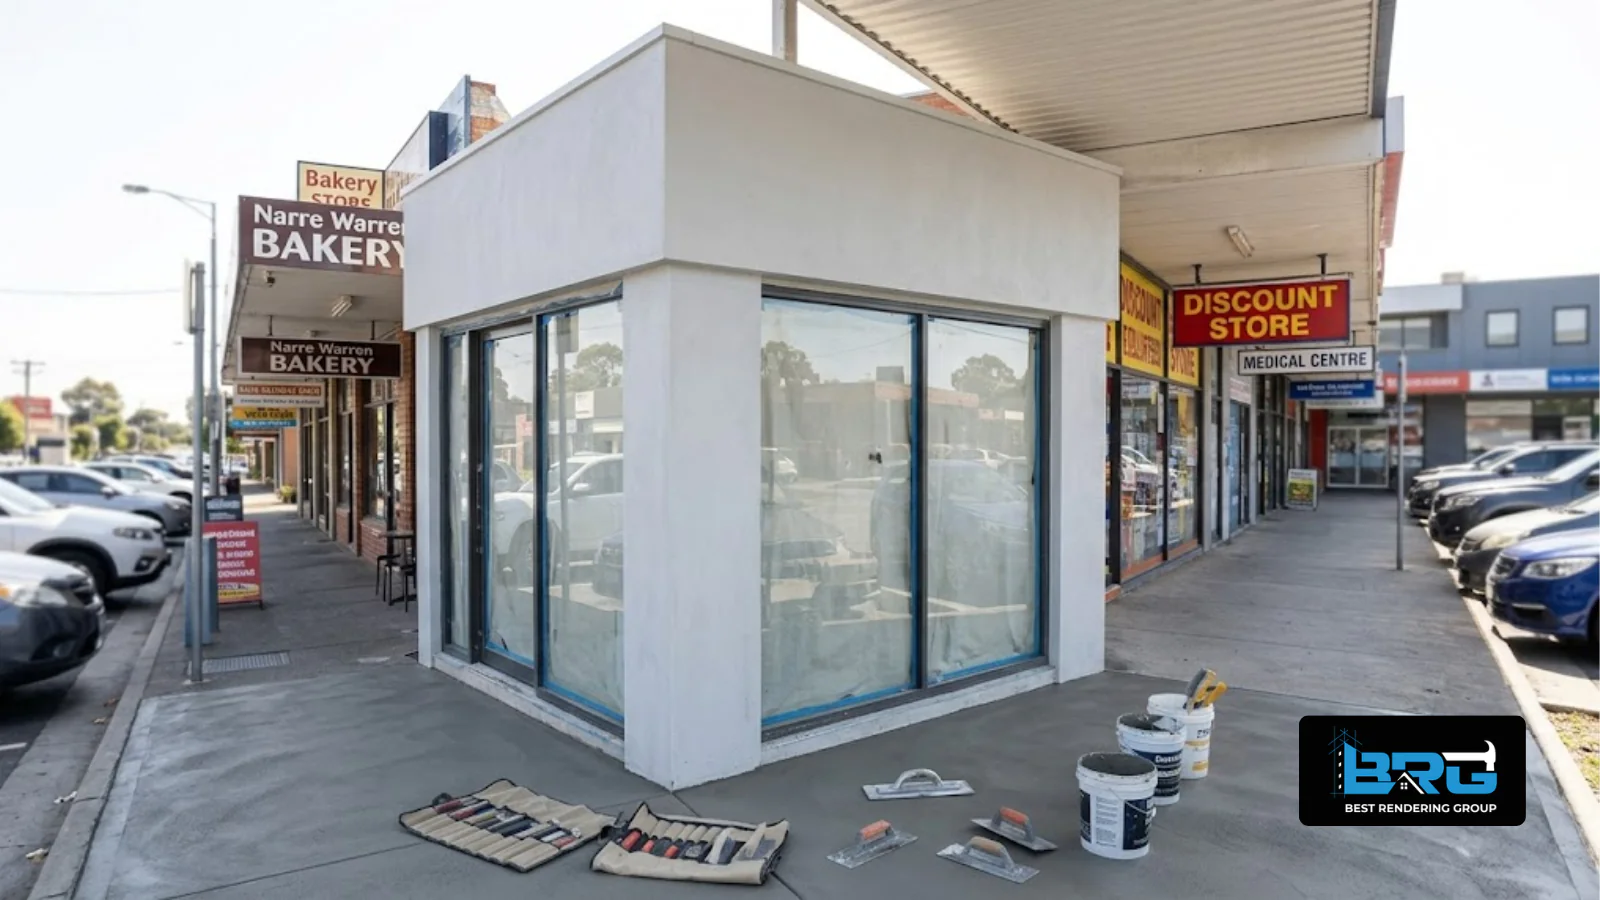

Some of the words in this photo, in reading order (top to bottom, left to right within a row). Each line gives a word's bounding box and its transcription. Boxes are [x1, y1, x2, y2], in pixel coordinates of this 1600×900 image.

[306, 169, 377, 195] Bakery
[254, 203, 323, 228] Narre
[1184, 284, 1338, 316] DISCOUNT
[1209, 313, 1310, 340] STORE
[270, 340, 314, 354] Narre
[317, 343, 374, 357] Warren
[1243, 354, 1306, 370] MEDICAL
[1310, 351, 1367, 368] CENTRE
[269, 355, 375, 374] BAKERY
